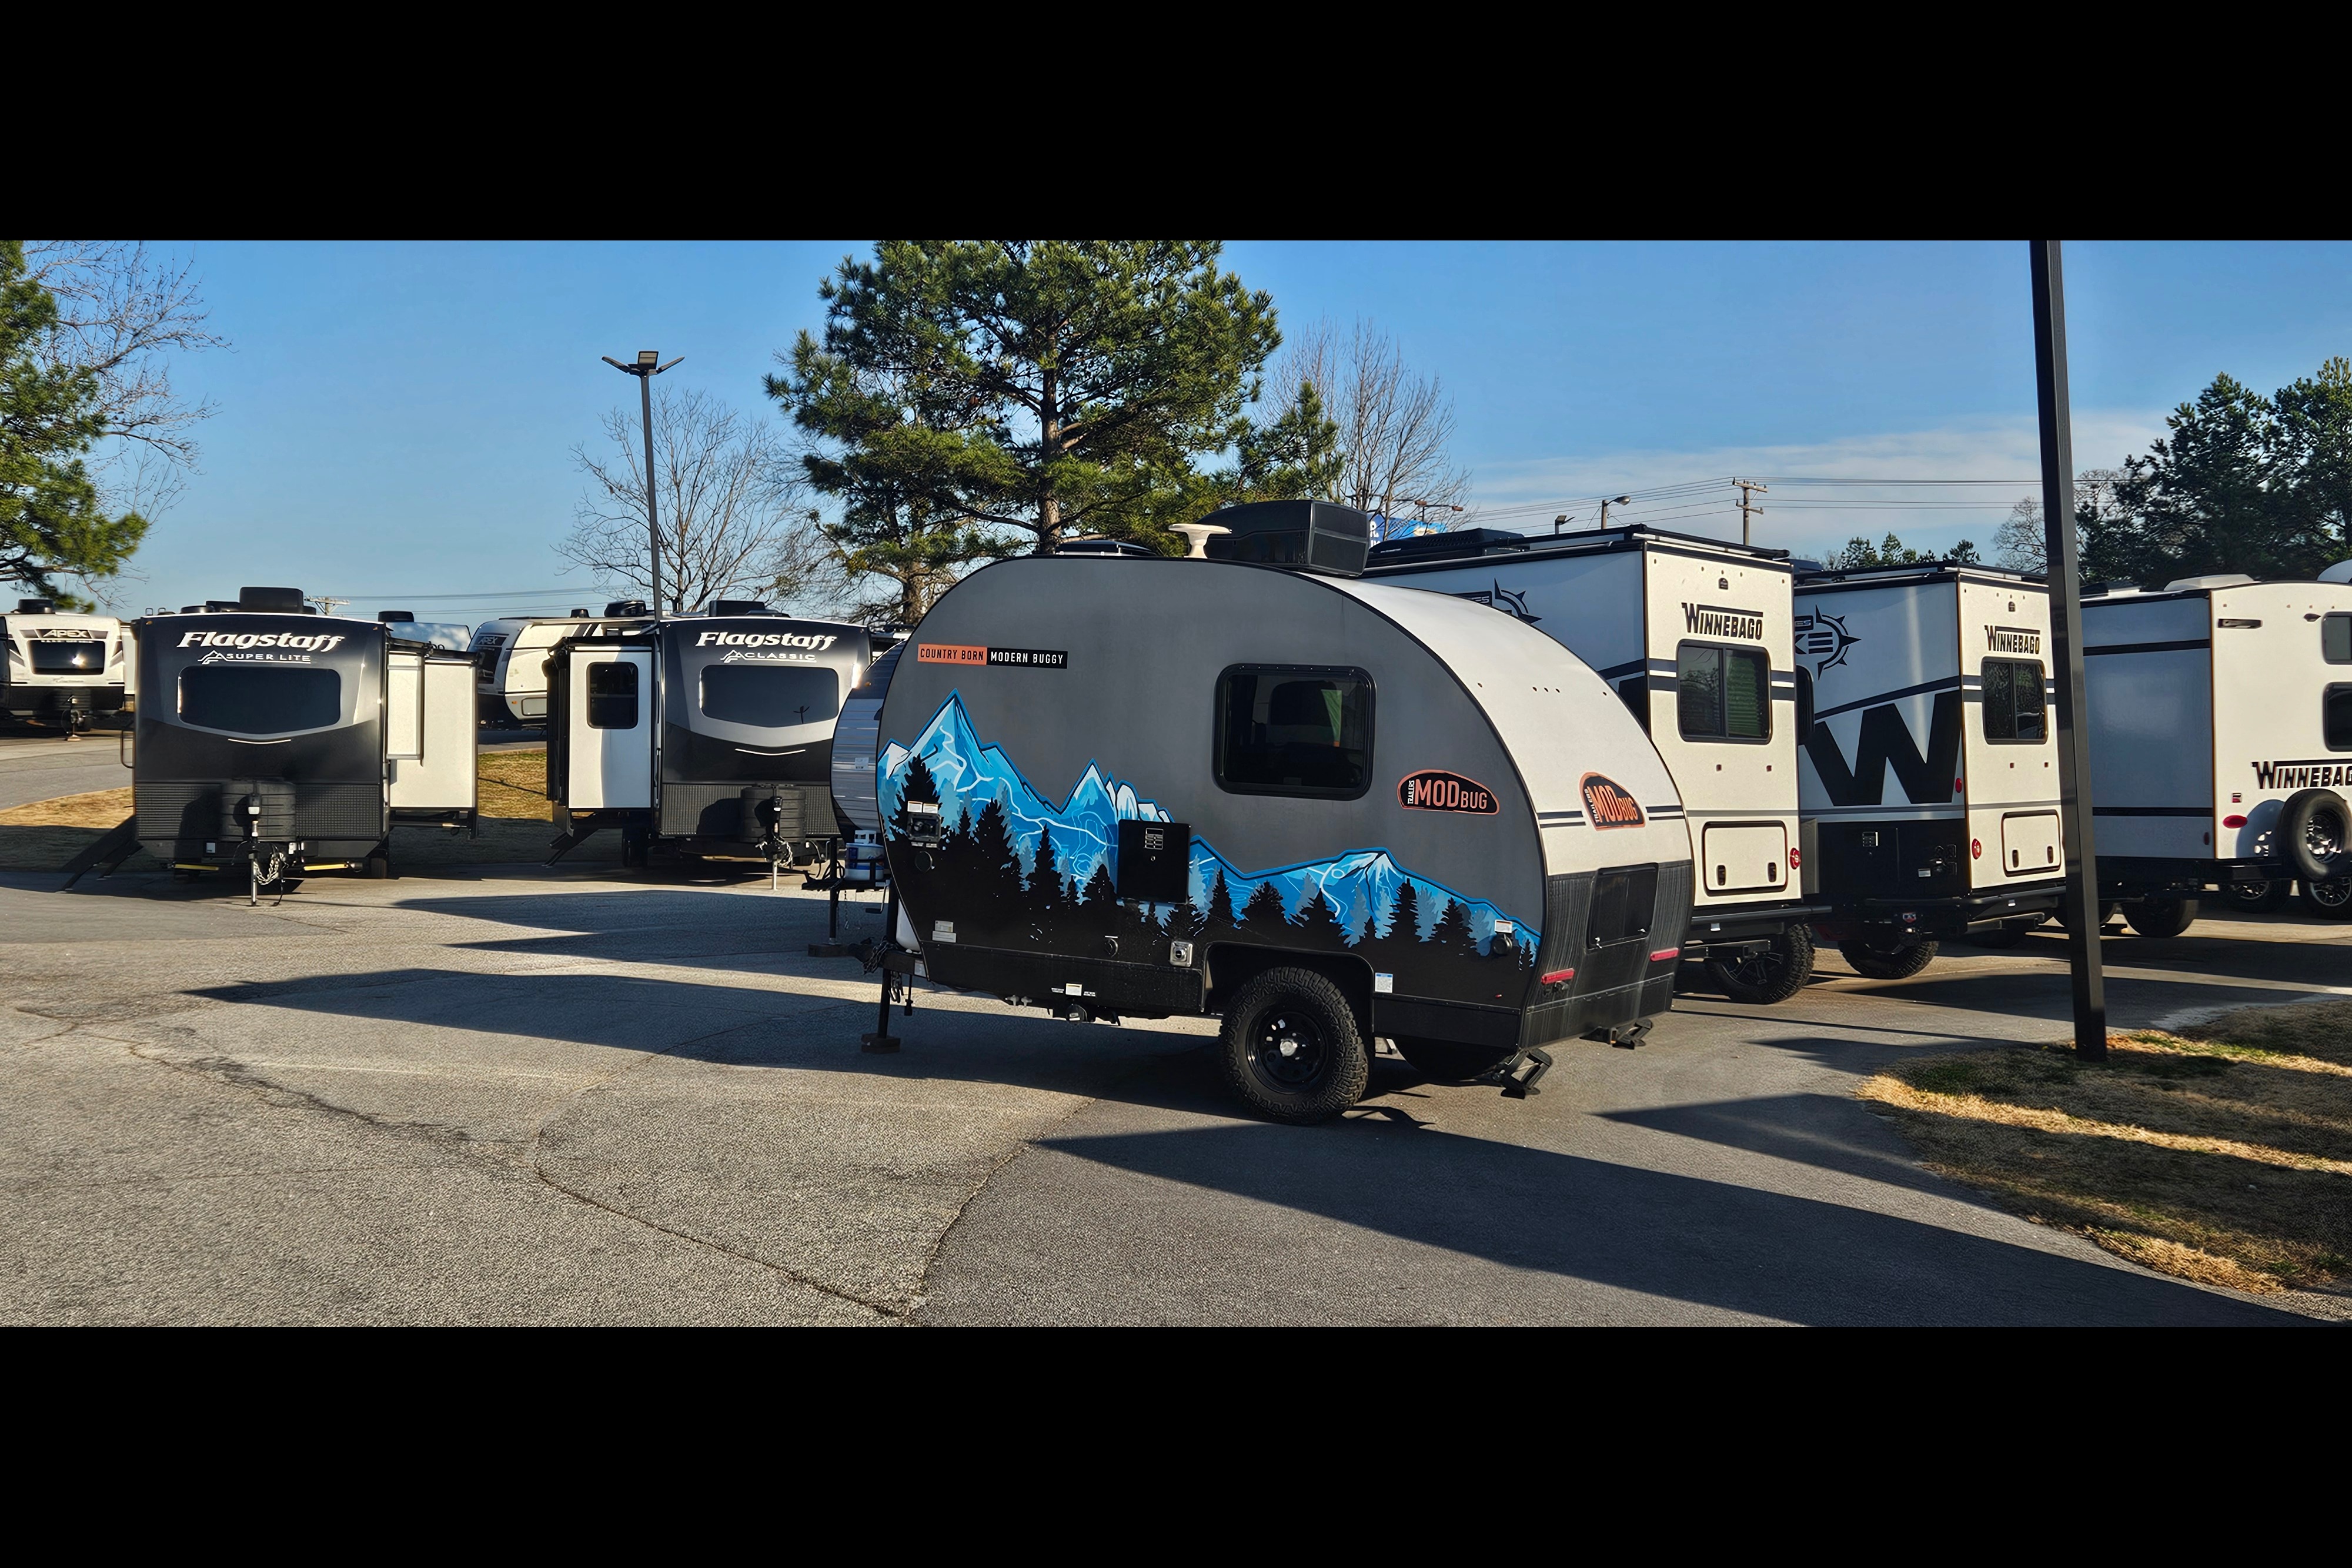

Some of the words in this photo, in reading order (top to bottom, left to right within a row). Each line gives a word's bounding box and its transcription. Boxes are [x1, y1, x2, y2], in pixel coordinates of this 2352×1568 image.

[1681, 602, 1763, 640] WINNEBAGO
[43, 630, 89, 638] APEX
[177, 631, 345, 652] Flagstaff
[696, 631, 837, 650] Flagstaff
[1984, 625, 2040, 654] WINNEBAGO
[920, 648, 958, 660] COUNTRY
[961, 650, 984, 661] BORN
[991, 651, 1028, 663] MODERN
[1033, 653, 1063, 664] BUGGY
[2251, 758, 2352, 789] WINNEBAG
